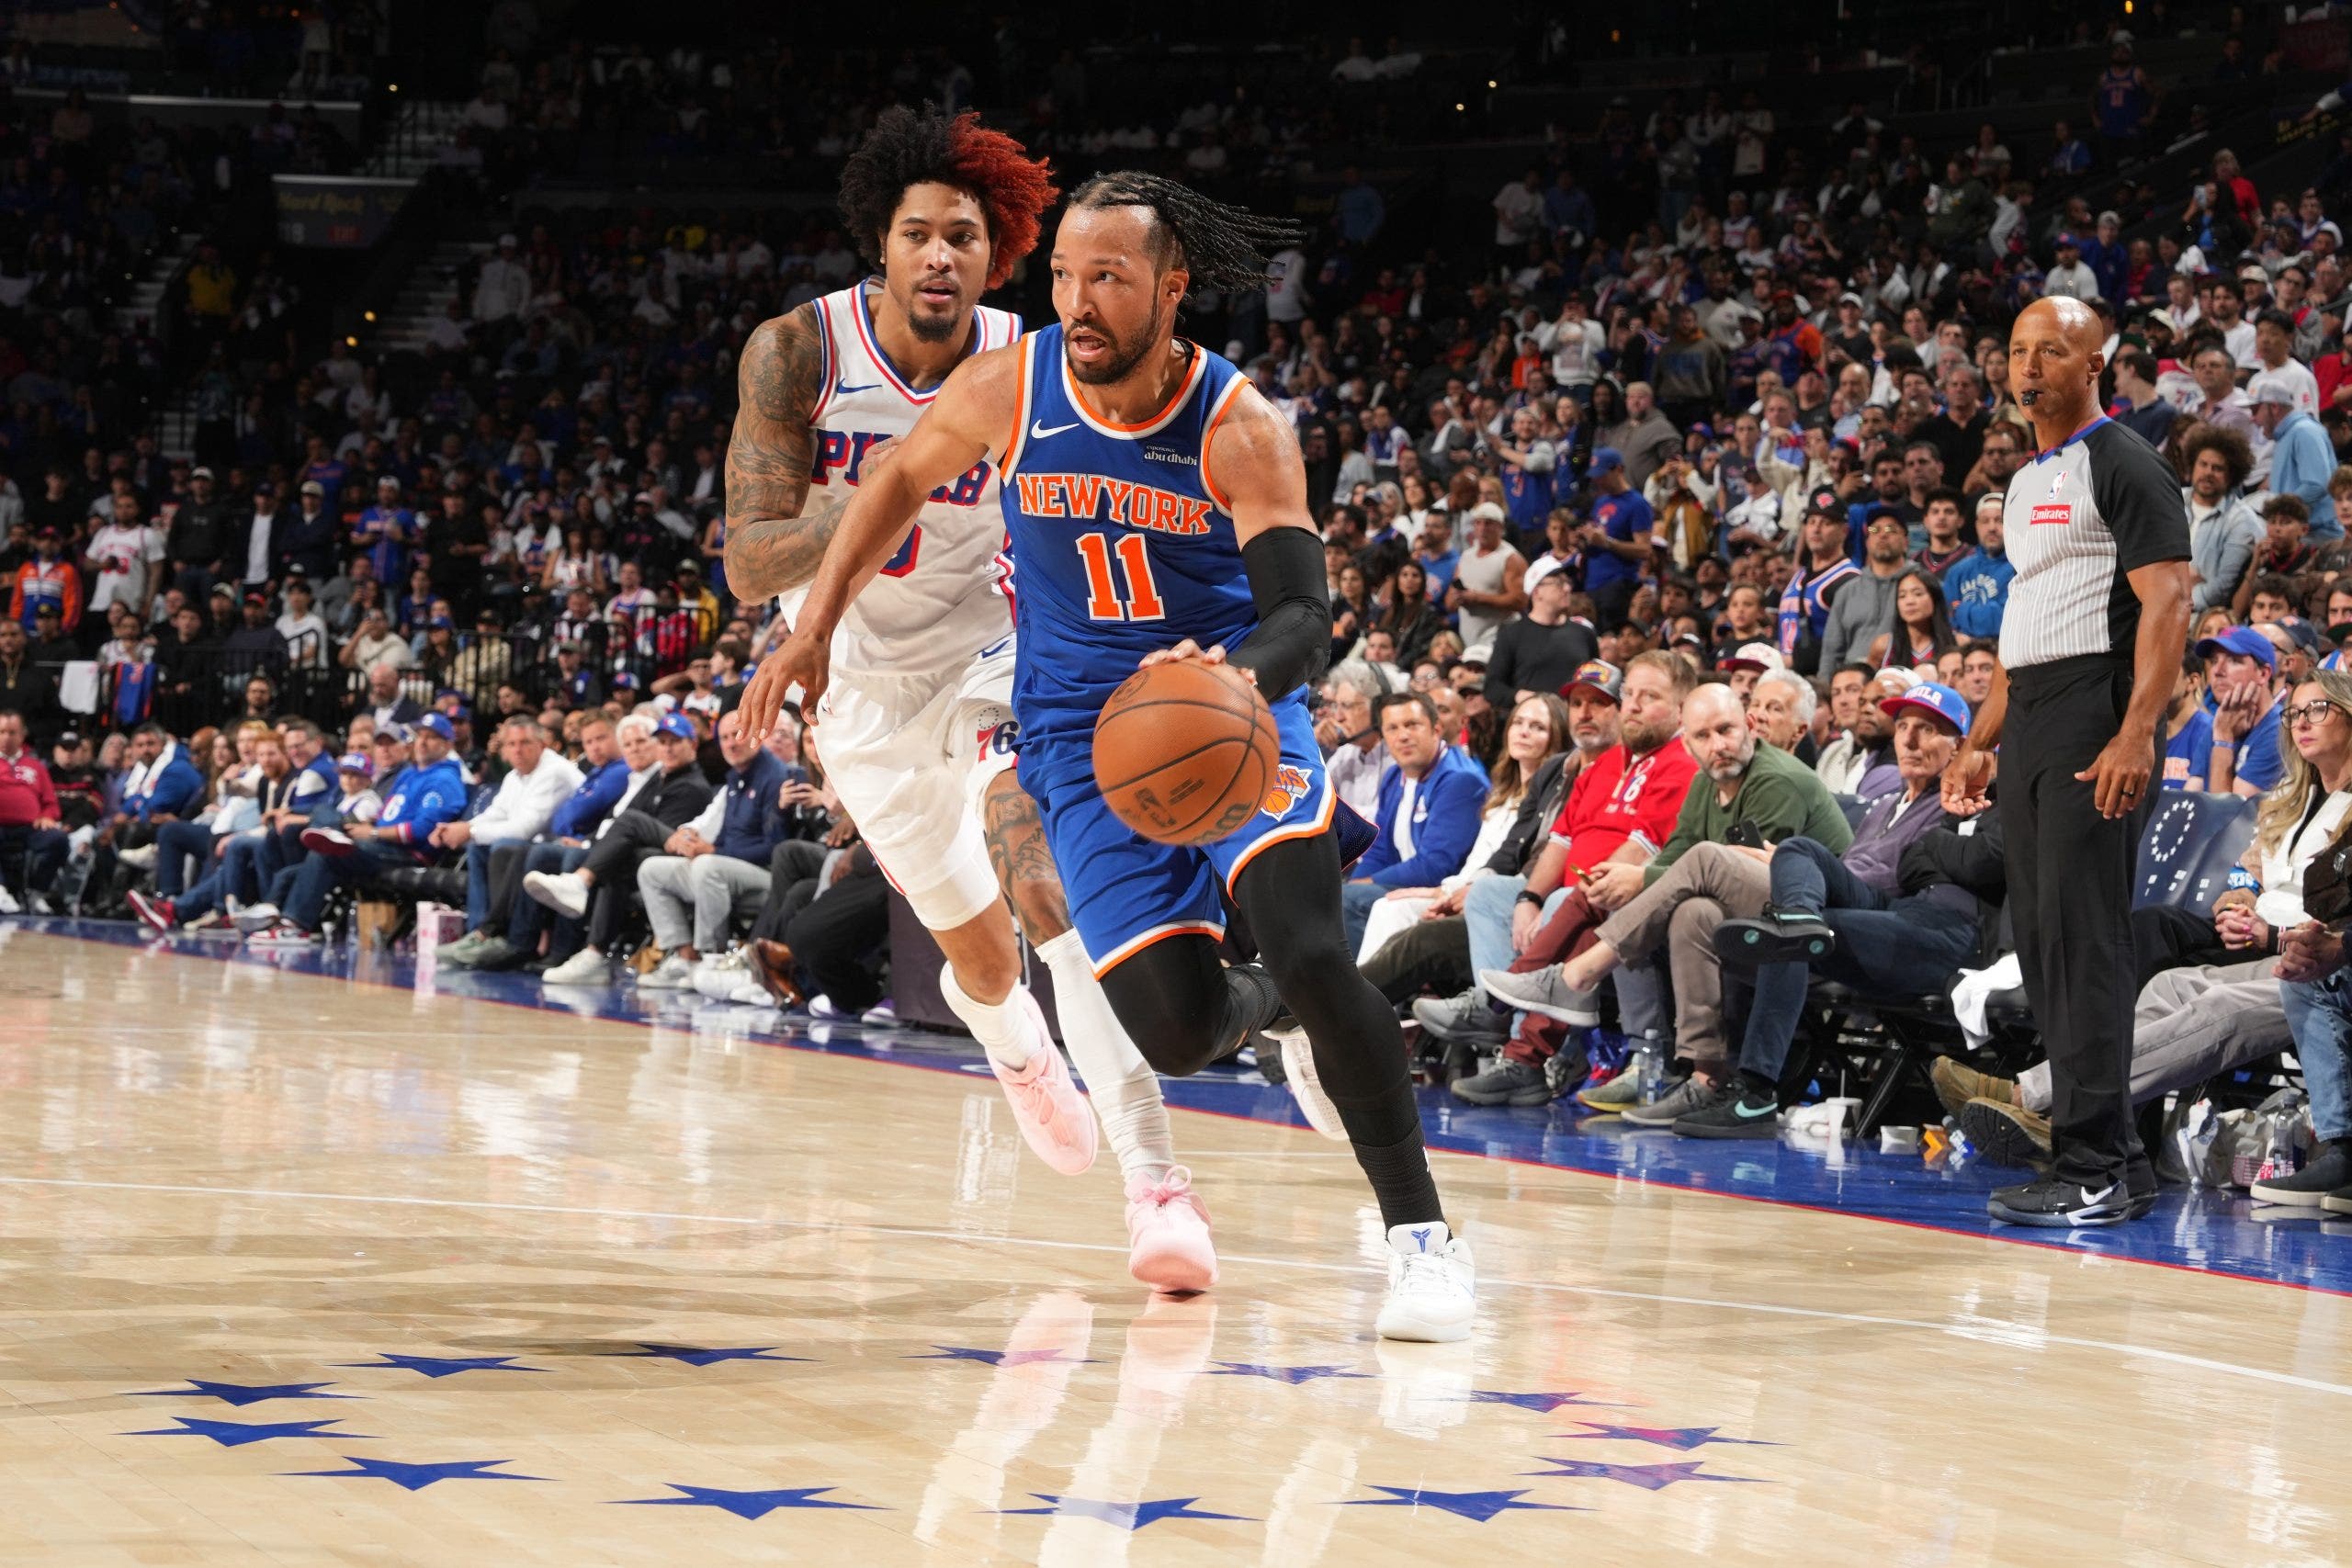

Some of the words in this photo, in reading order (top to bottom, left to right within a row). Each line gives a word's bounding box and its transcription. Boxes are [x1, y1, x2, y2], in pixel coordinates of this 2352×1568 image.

[1144, 451, 1166, 461] abu
[1167, 454, 1198, 466] dhabi
[1016, 473, 1103, 520] NEW
[1103, 475, 1214, 536] YORK
[2031, 508, 2069, 522] Emirates
[1076, 533, 1165, 622] 11
[977, 722, 1019, 763] 76
